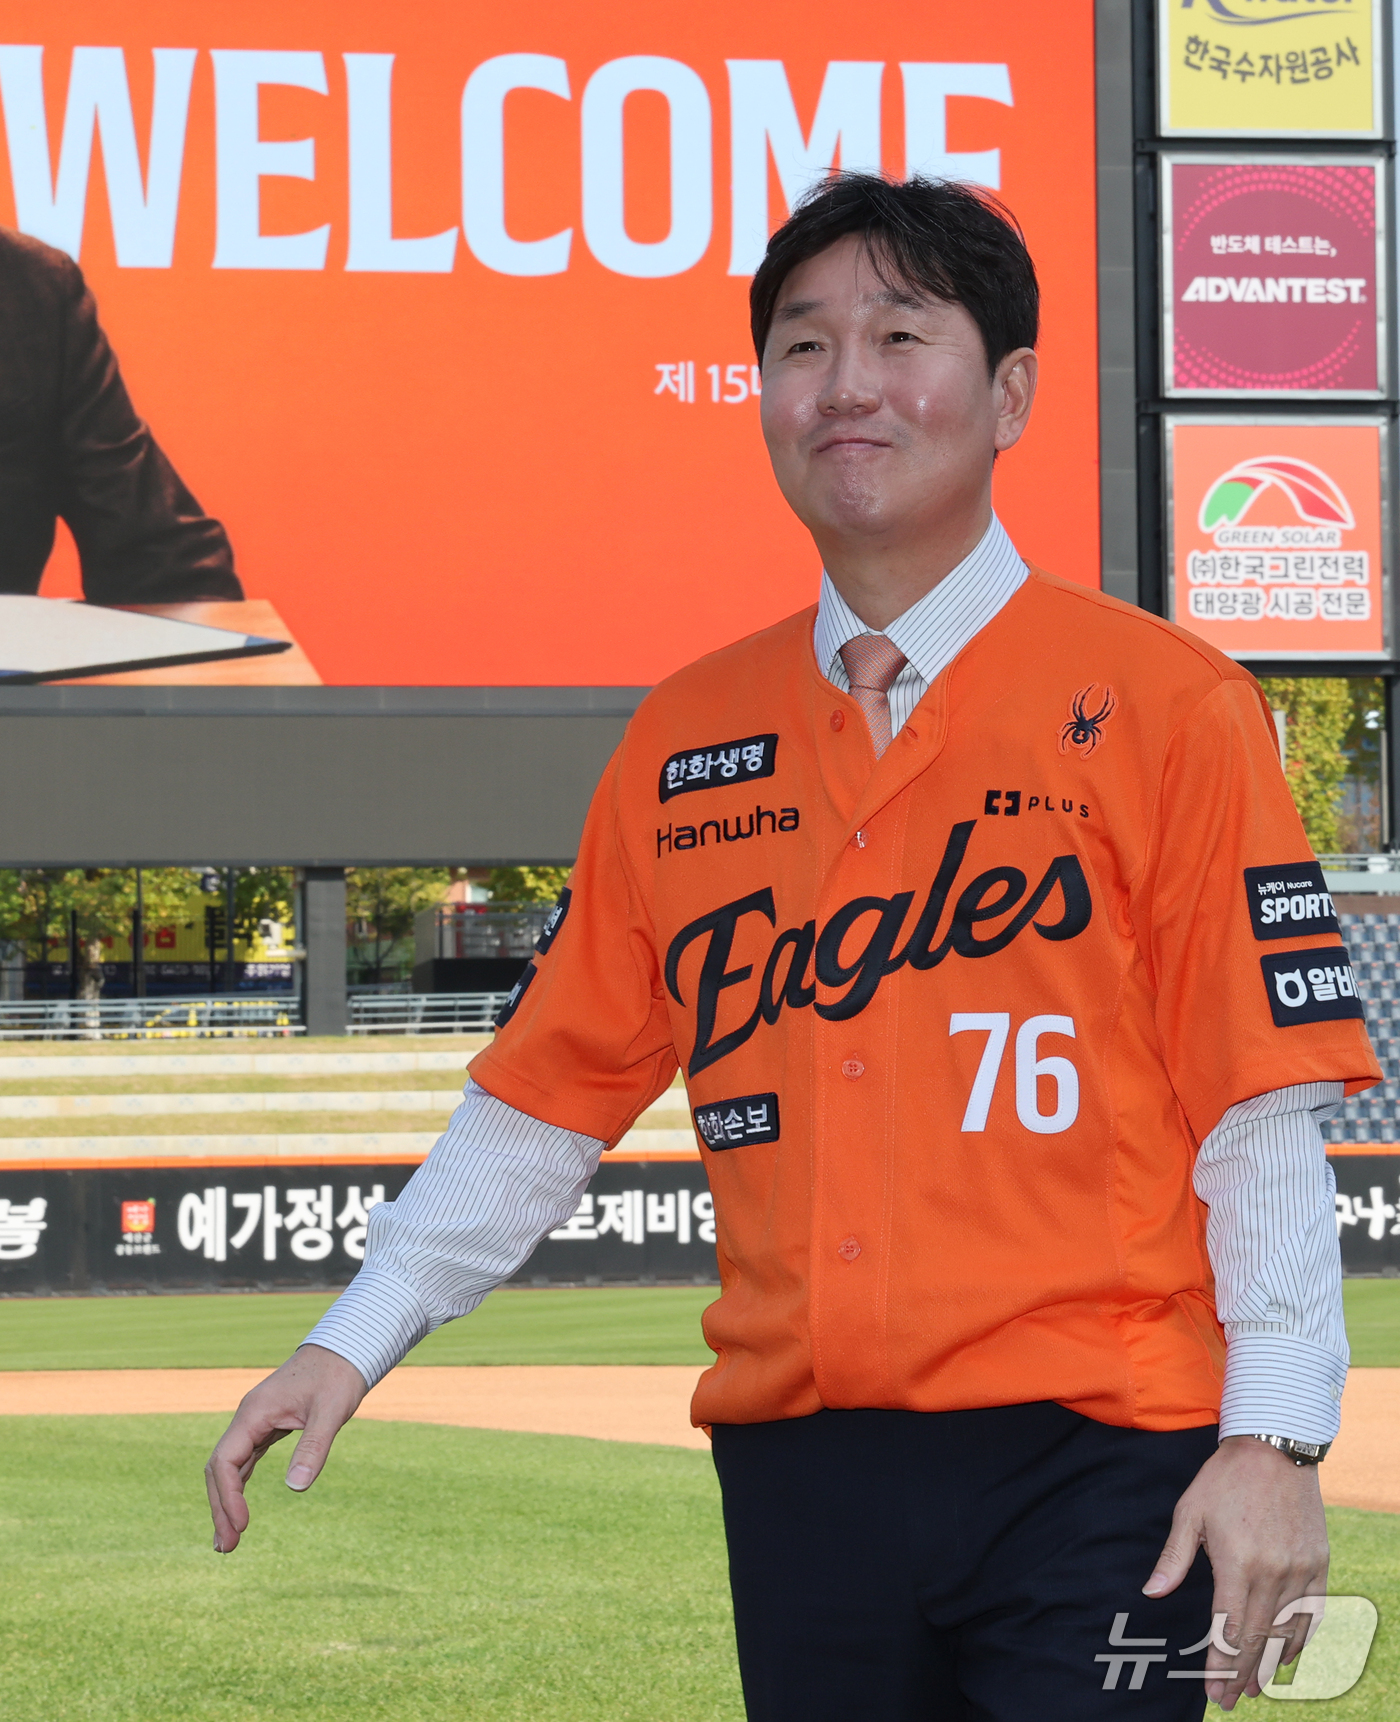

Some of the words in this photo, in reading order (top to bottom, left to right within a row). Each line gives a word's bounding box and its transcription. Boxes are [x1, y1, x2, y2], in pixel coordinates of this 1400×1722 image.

[1184, 35, 1361, 85] 한국수자원공사
[0, 44, 1014, 278] WELCOME
[1210, 234, 1261, 255] 반도체
[1264, 234, 1338, 258] 테스트는,
[1181, 276, 1367, 304] ADVANTEST
[654, 360, 695, 404] 제
[1217, 530, 1277, 545] GREEN
[1280, 530, 1338, 545] SOLAR
[1194, 591, 1262, 615] 태양광
[1269, 591, 1314, 615] 시공
[1321, 591, 1366, 615] 전문
[666, 741, 765, 790] 한화생명
[1028, 795, 1090, 818] PLUS
[657, 805, 800, 858] Hanwha
[1257, 881, 1286, 895] 뉴케어
[1286, 880, 1313, 890] Nucare
[664, 818, 1093, 1079] Eagles
[948, 1012, 1081, 1134] 76
[697, 1103, 771, 1146] 한화손보
